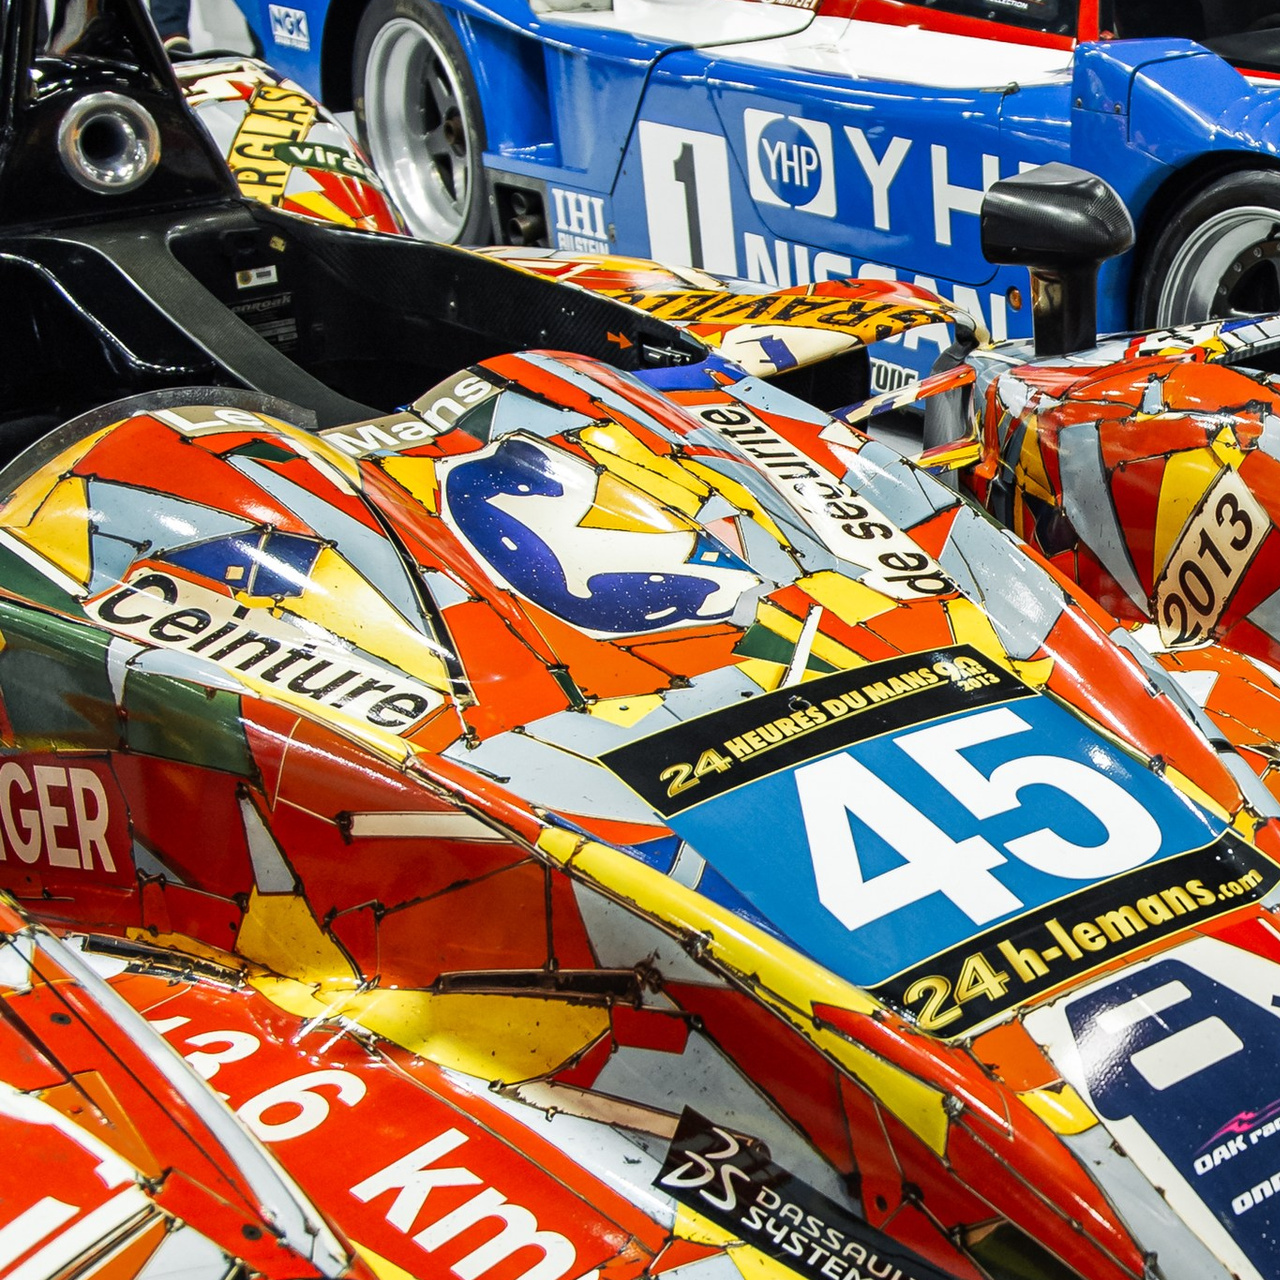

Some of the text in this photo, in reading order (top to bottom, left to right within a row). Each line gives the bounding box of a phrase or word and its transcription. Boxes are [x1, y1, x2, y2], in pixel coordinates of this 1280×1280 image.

[269, 7, 308, 37] NGK
[672, 142, 704, 271] 1
[761, 136, 818, 188] YHP
[844, 126, 1041, 246] YH
[551, 187, 609, 240] IHI
[158, 376, 494, 456] Le Mans
[878, 551, 952, 596] de
[1163, 491, 1257, 646] 2013
[99, 571, 429, 730] Ceinture
[961, 673, 1001, 693] 2013
[659, 655, 979, 798] 24 HEURES DU MANS 90
[0, 761, 117, 873] GER
[793, 706, 1163, 933] 45
[1193, 1134, 1248, 1176] OAK
